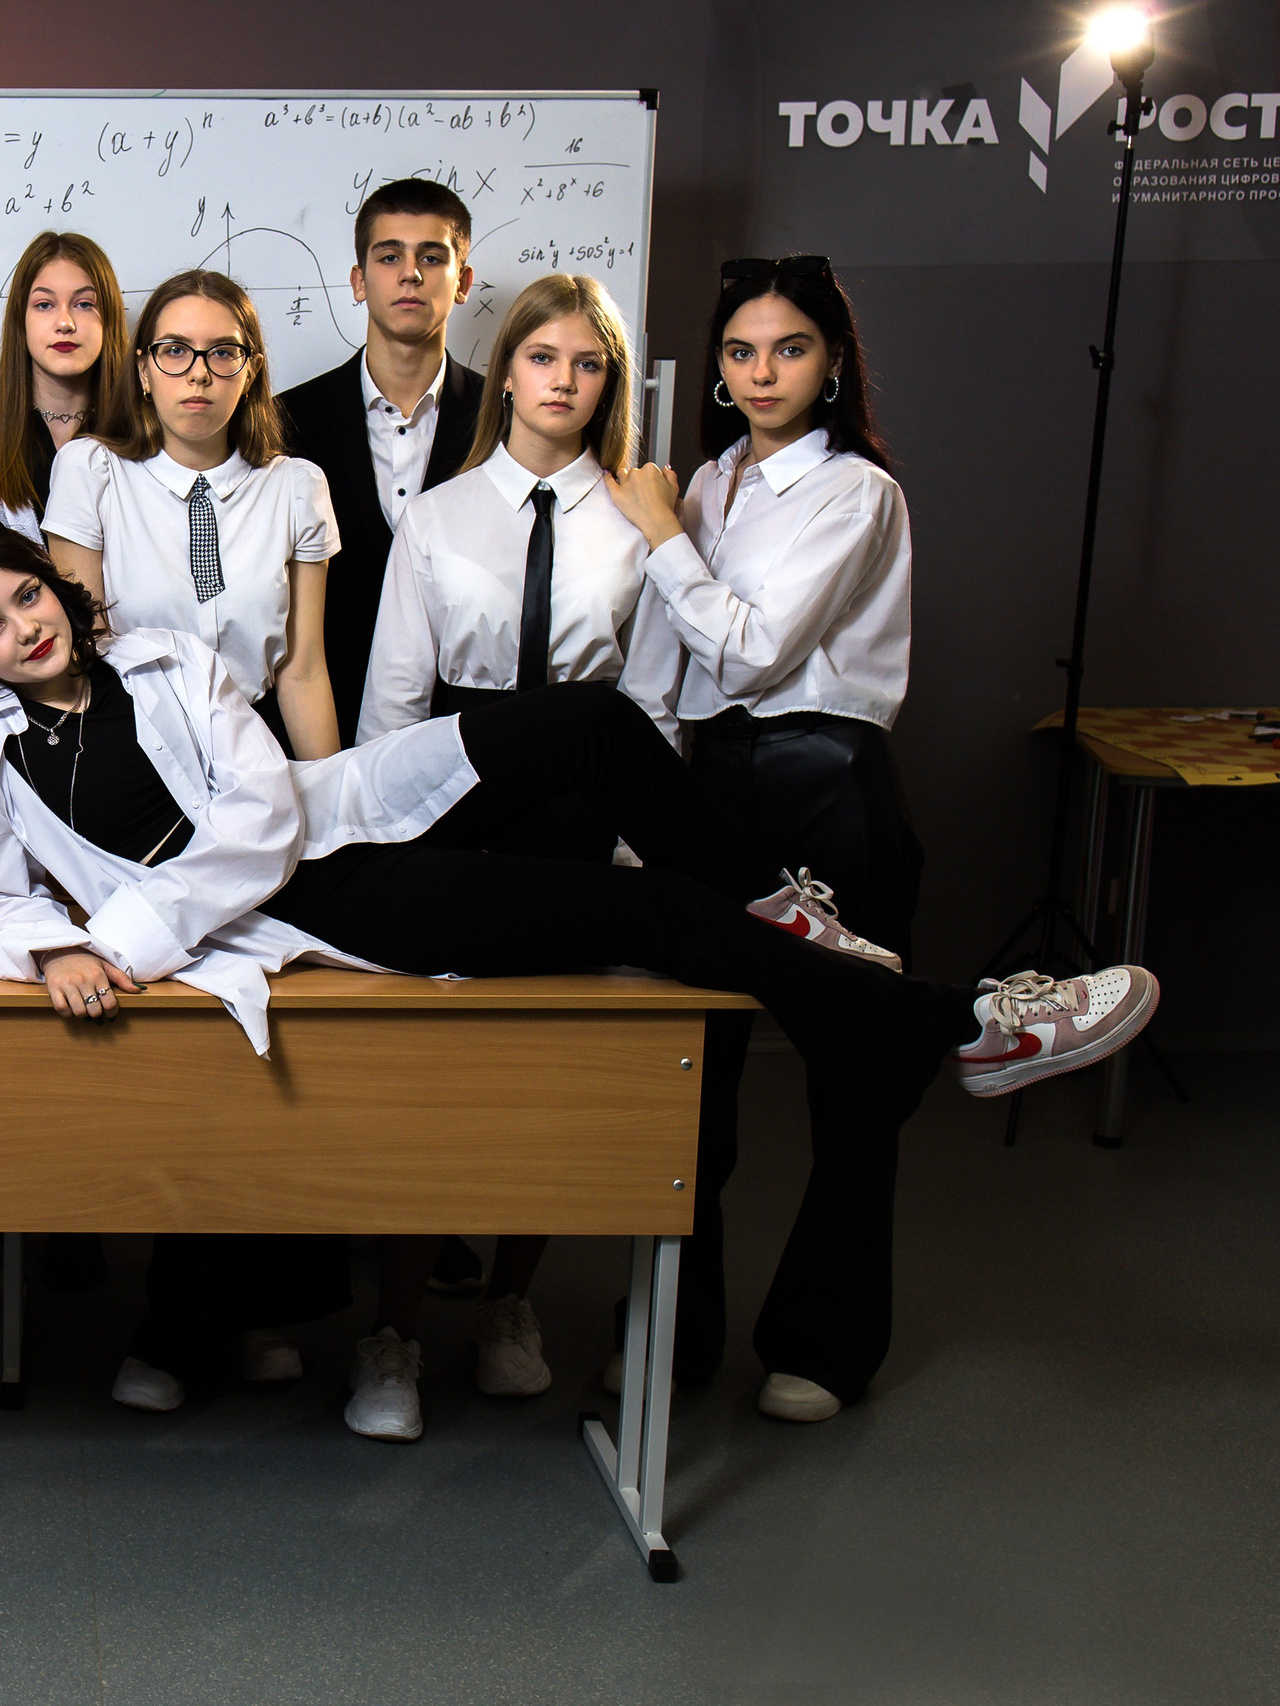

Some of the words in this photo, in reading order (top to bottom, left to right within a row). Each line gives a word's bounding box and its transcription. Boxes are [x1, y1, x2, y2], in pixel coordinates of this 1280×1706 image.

[778, 98, 1000, 148] ТОЧКА
[1114, 159, 1219, 172] ФДЕРАЛЬНАЯ
[1223, 157, 1259, 168] СЕТЬ
[1113, 174, 1217, 188] ОРАЗОВАНИЯ
[1221, 172, 1280, 187] ЦИФРОВ
[1128, 189, 1245, 204] УМАНИТАРНОГО
[1249, 189, 1280, 201] ПРО
